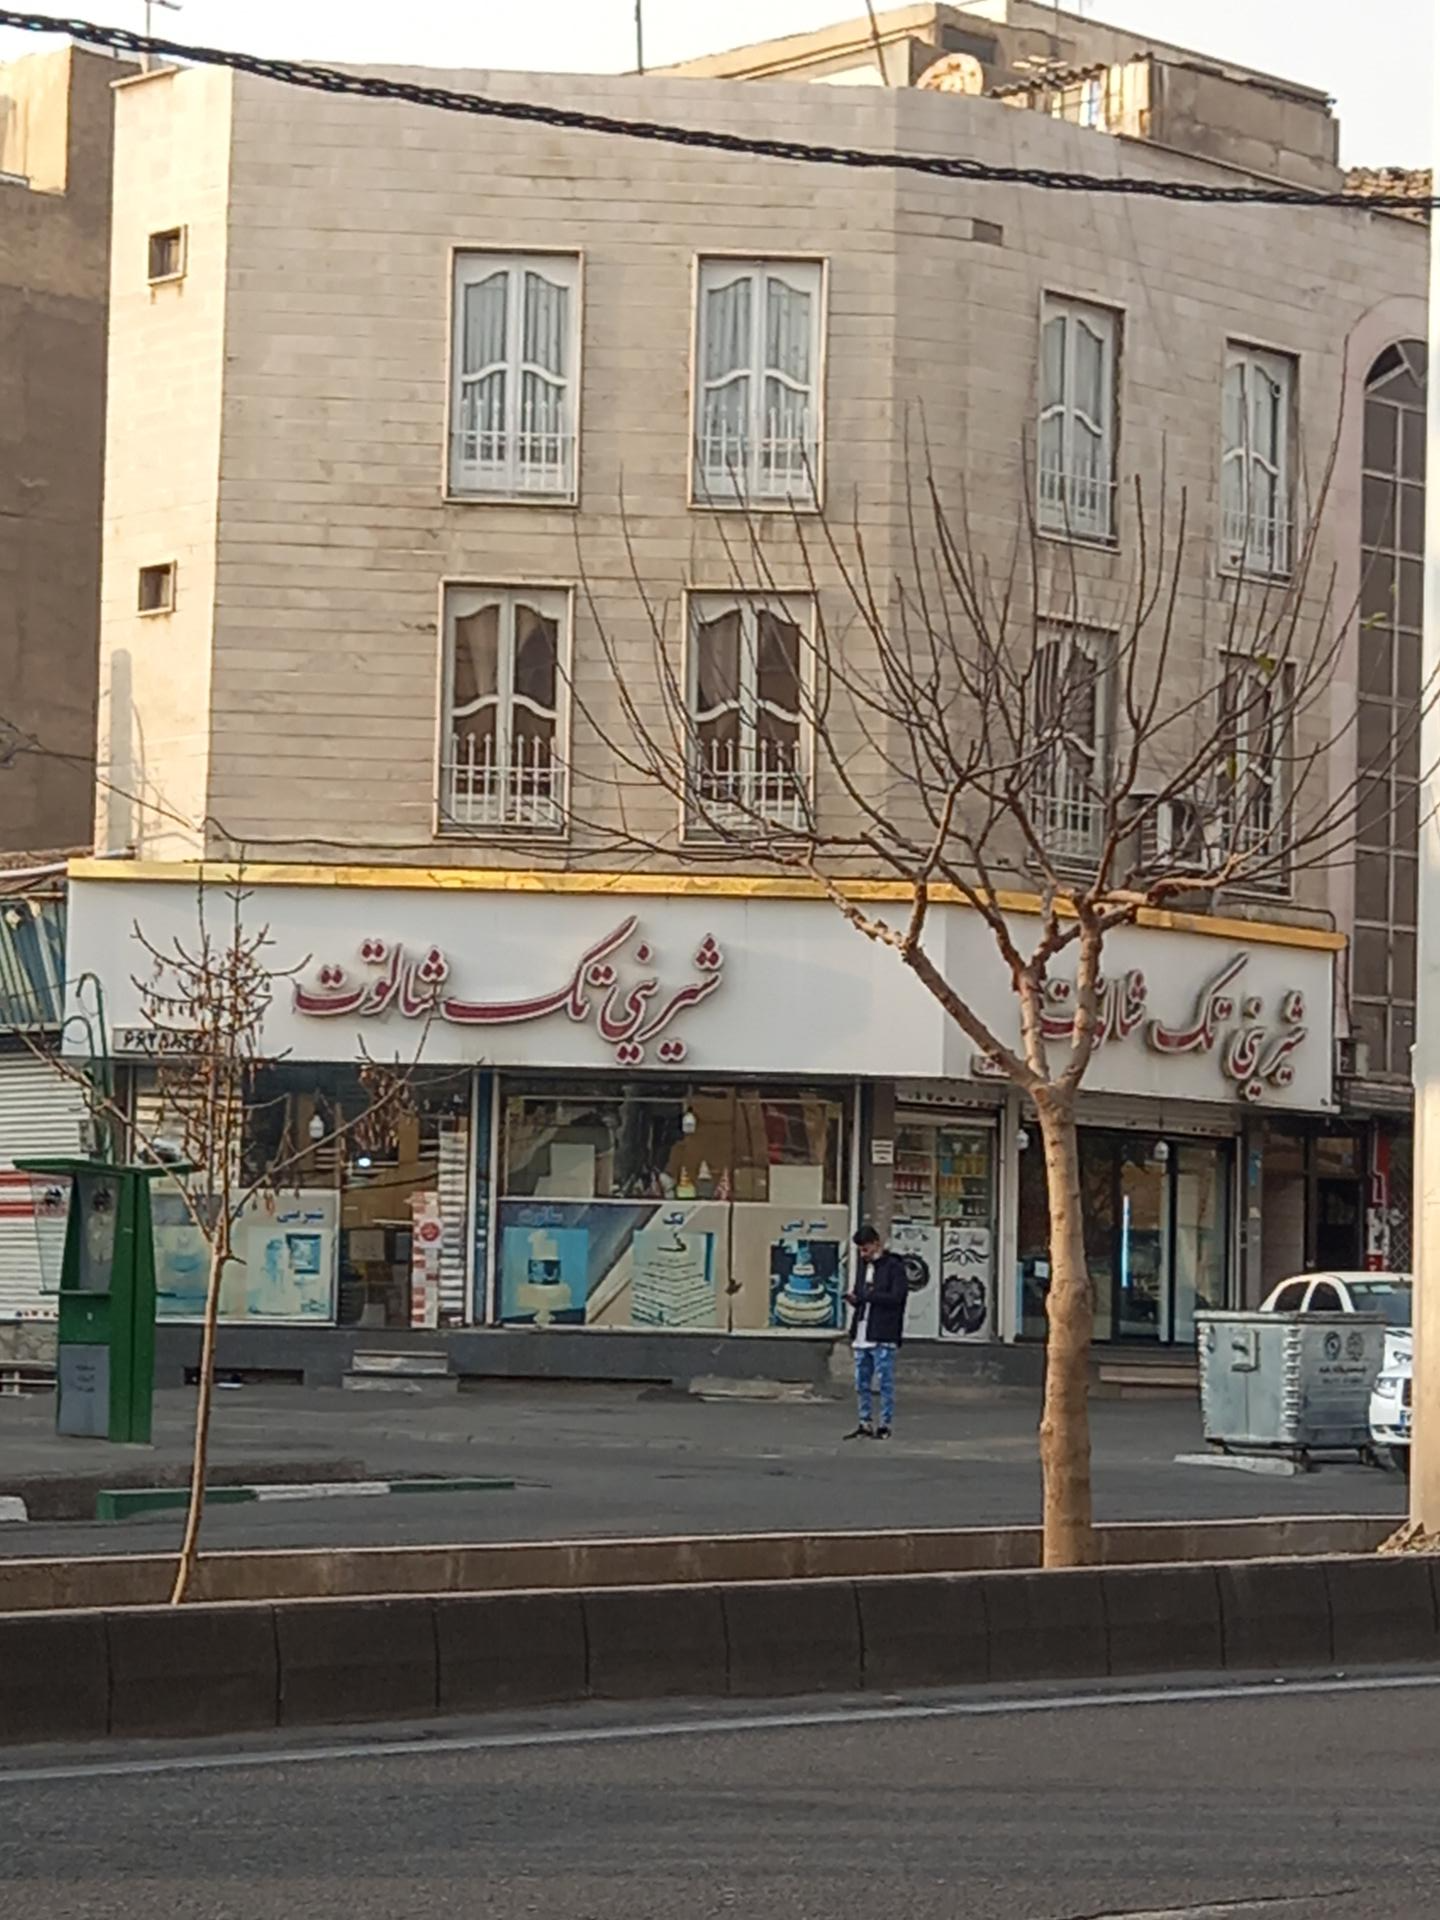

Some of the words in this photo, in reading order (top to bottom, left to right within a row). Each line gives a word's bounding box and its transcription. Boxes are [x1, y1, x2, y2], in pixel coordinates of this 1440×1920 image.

[439, 915, 639, 1024] تک
[599, 933, 724, 1064] شیرینی
[1150, 952, 1249, 1053] تک
[1226, 990, 1308, 1101] شیرینی
